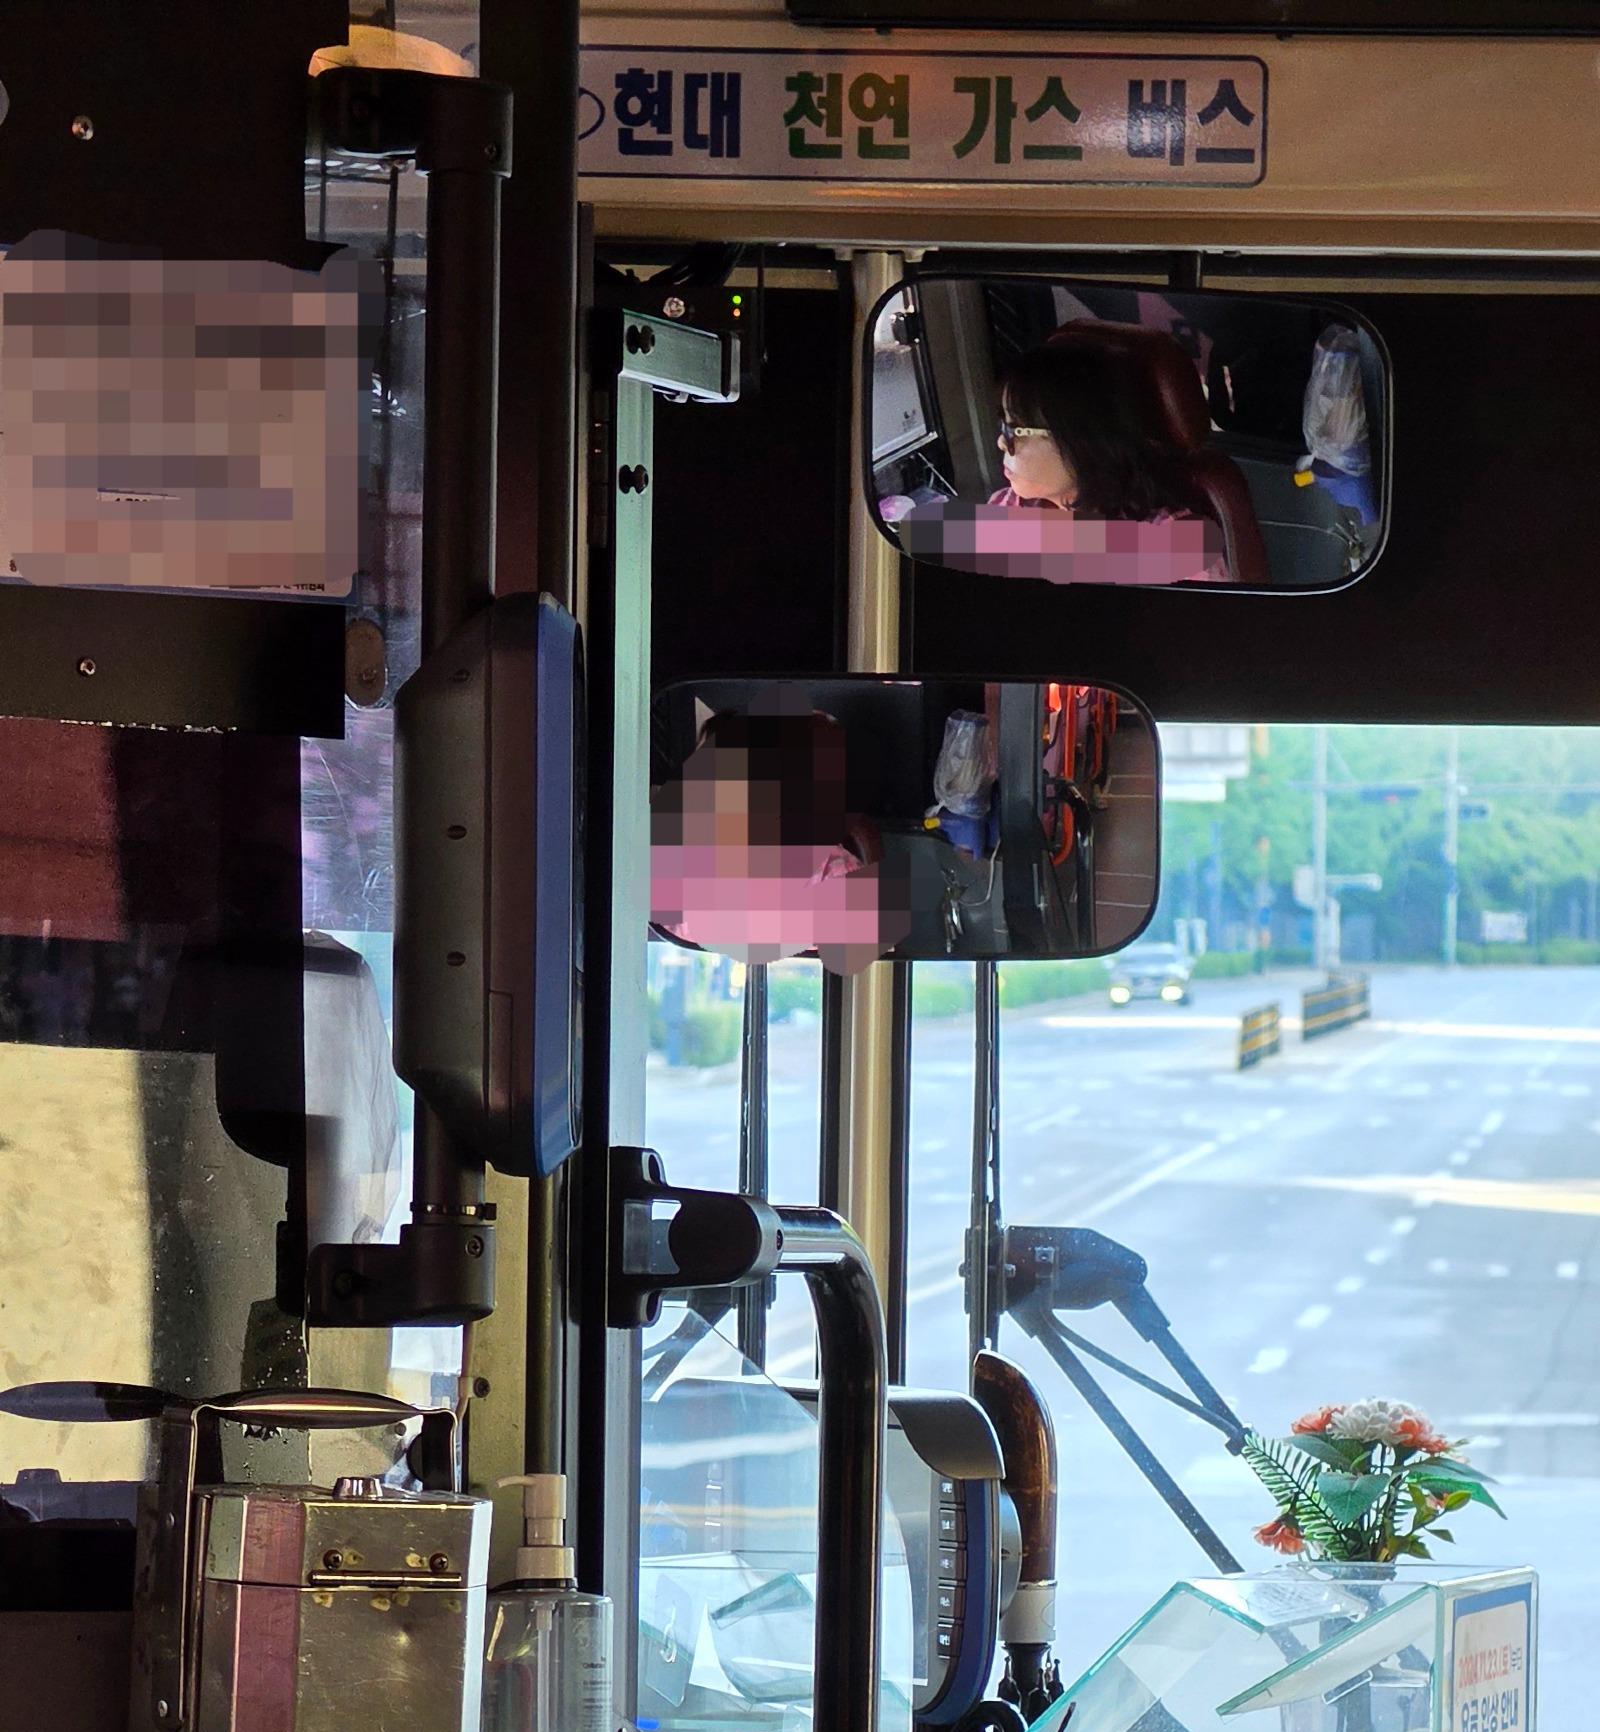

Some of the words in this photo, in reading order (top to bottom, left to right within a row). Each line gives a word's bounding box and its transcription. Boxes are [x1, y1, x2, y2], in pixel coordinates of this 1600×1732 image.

[613, 67, 741, 158] 현대
[783, 71, 911, 160] 천연
[952, 75, 1083, 165] 가스
[1126, 78, 1256, 167] 버스
[1501, 1687, 1519, 1731] 안내
